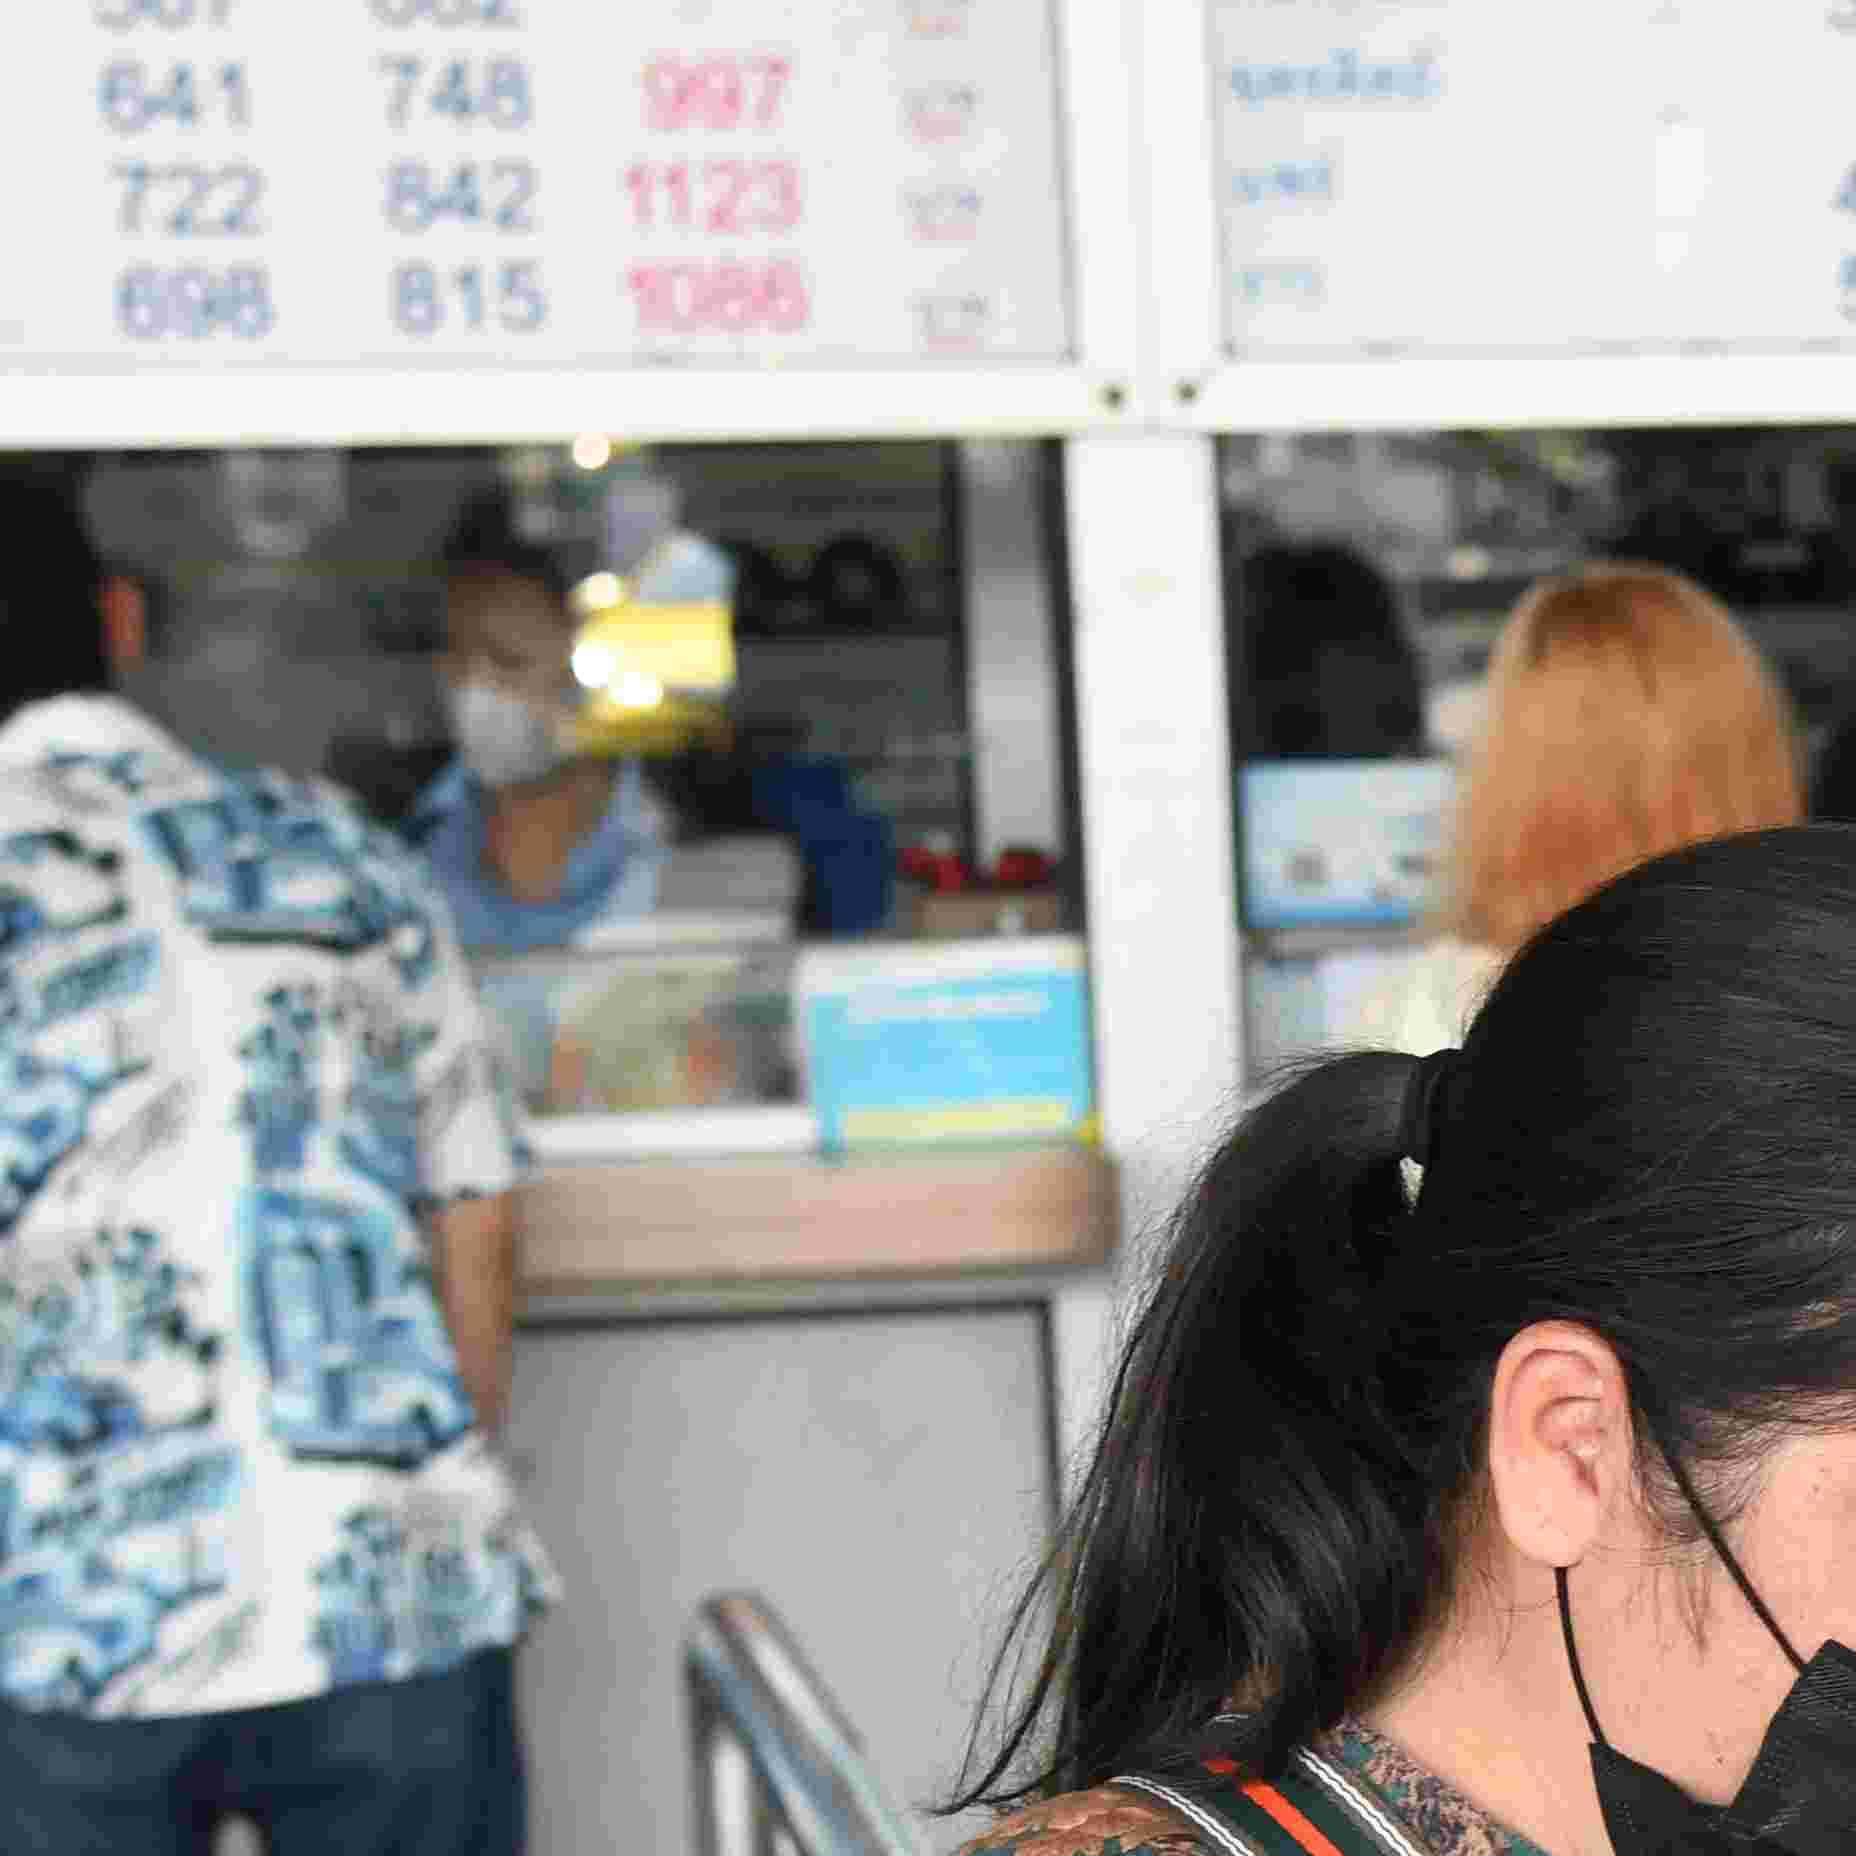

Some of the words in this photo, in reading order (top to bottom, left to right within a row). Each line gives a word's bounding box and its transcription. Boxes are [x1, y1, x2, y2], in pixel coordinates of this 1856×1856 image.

[95, 60, 249, 136] 641
[380, 55, 532, 129] 748
[641, 54, 794, 131] 997
[110, 158, 266, 240] 722
[383, 159, 536, 233] 842
[622, 158, 803, 238] 1123
[113, 264, 276, 340] 698
[390, 259, 549, 338] 815
